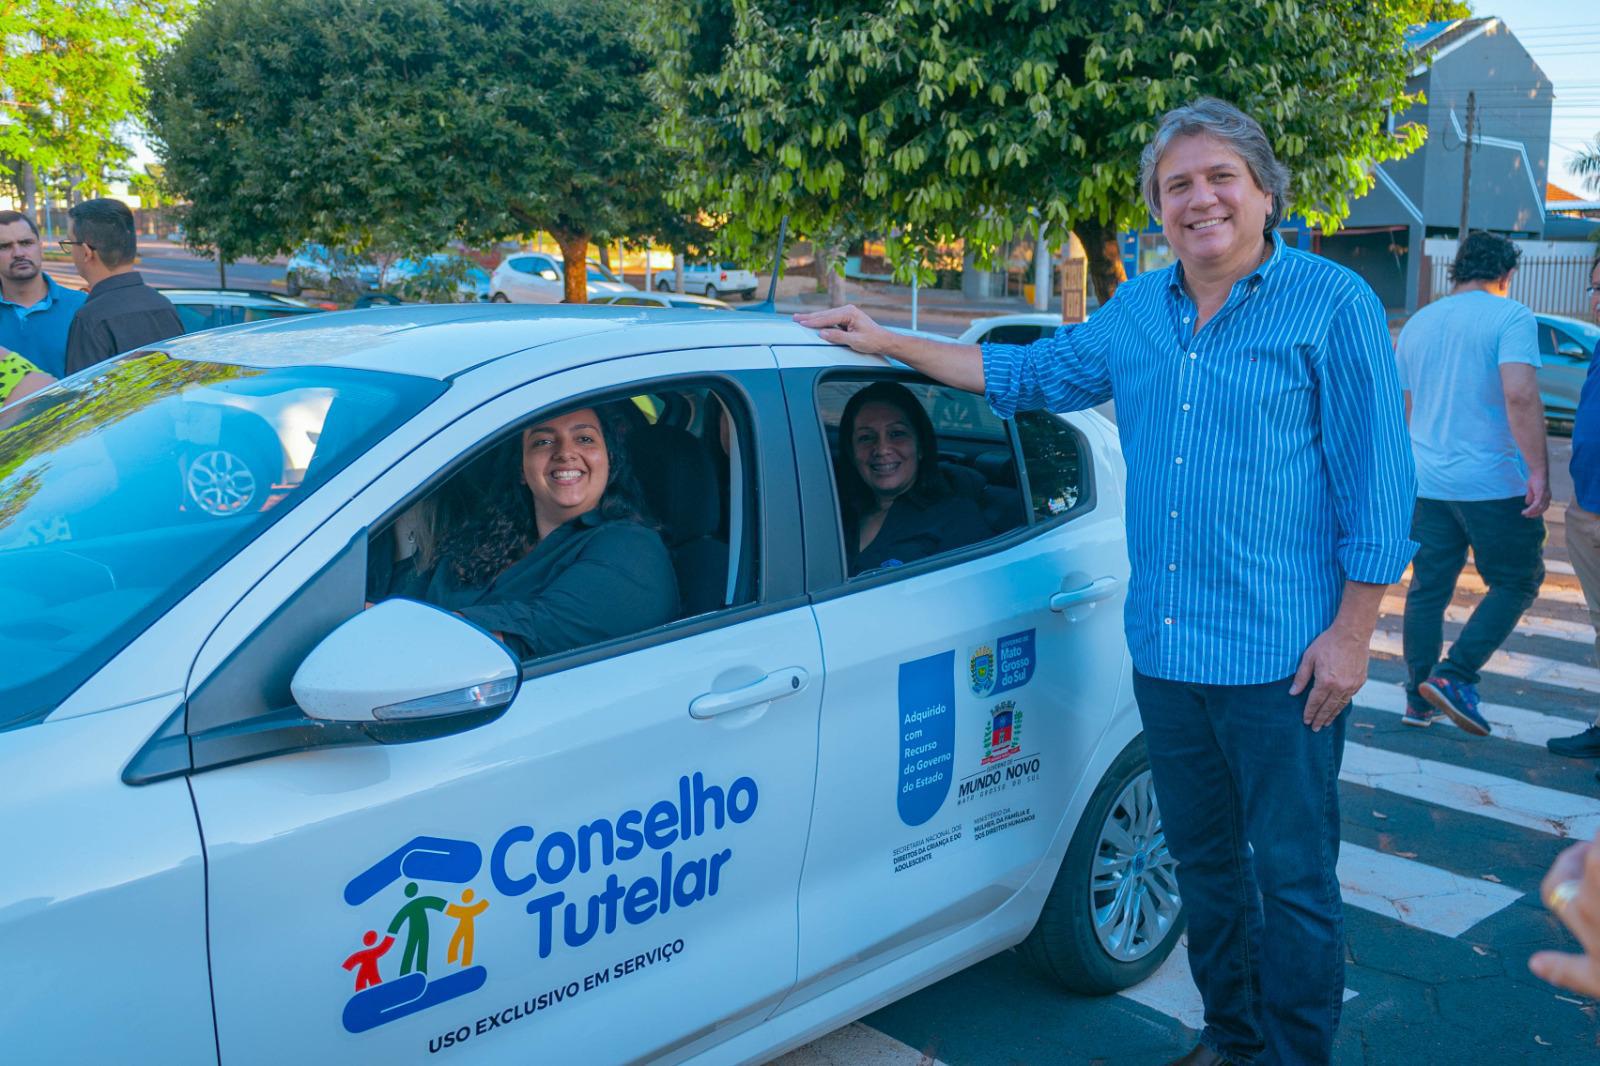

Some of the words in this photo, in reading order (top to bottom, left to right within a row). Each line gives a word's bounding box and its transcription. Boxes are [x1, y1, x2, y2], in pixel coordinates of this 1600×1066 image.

[1001, 646, 1021, 661] Mato
[1002, 657, 1029, 673] Grosso
[1002, 676, 1013, 686] do
[1014, 670, 1026, 683] Sul
[904, 704, 946, 724] Adquirido
[905, 730, 922, 742] com
[905, 741, 937, 759] Recurso
[904, 763, 914, 775] do
[916, 752, 951, 771] Governo
[903, 782, 914, 793] do
[916, 771, 943, 788] Estado
[958, 771, 1001, 798] MUNDO
[1006, 759, 1040, 781] NOVO
[957, 794, 975, 806] MATO
[980, 783, 1005, 798] GROSSO
[1013, 779, 1021, 787] DO
[1027, 774, 1040, 783] SUL
[1005, 810, 1025, 821] FAMÍLIA
[490, 771, 759, 897] Conselho
[975, 832, 985, 840] DOS
[986, 823, 1008, 836] DIREITOS
[1008, 814, 1035, 827] HUMANOS
[893, 839, 925, 856] SECRETARIA
[926, 829, 950, 843] NACIONAL
[951, 824, 962, 833] DOS
[893, 850, 918, 864] DIREITOS
[918, 846, 926, 855] DA
[927, 837, 949, 851] CRIANÇA
[954, 832, 962, 840] DO
[894, 853, 932, 873] ADOLESCENTE
[526, 848, 732, 959] Tutelar
[429, 1025, 470, 1054] USO
[475, 982, 579, 1036] EXCLUSIVO
[584, 968, 610, 991] EM
[614, 939, 684, 979] SERVIÇO
